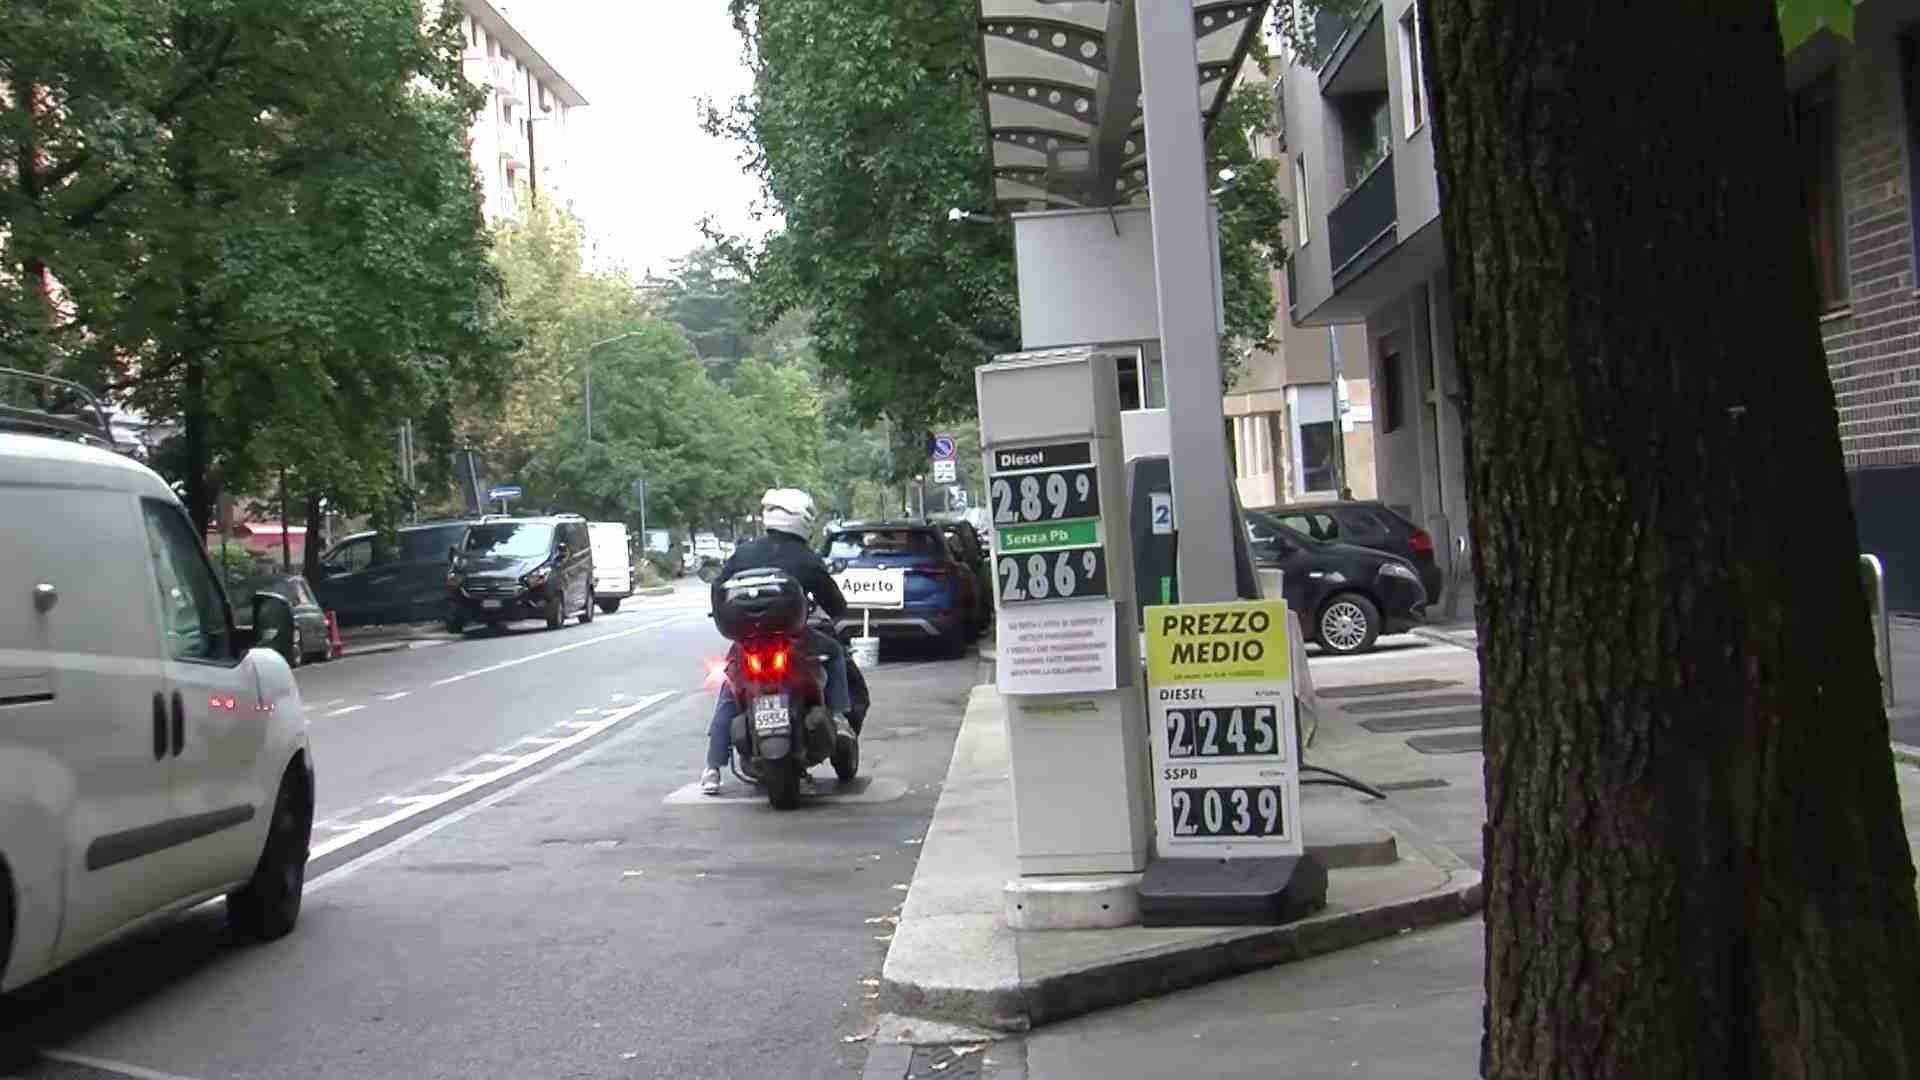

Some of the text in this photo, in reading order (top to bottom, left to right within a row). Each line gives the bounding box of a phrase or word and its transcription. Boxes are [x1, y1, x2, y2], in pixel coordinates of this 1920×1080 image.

[1000, 452, 1044, 466] Diesel
[1155, 505, 1169, 524] 2
[1006, 530, 1068, 546] Senza Pb
[842, 579, 893, 595] Aperto
[1162, 610, 1270, 637] PREZZO
[1171, 639, 1265, 665] MEDIO
[1160, 688, 1206, 701] DIESEL
[1164, 768, 1199, 781] SSPB
